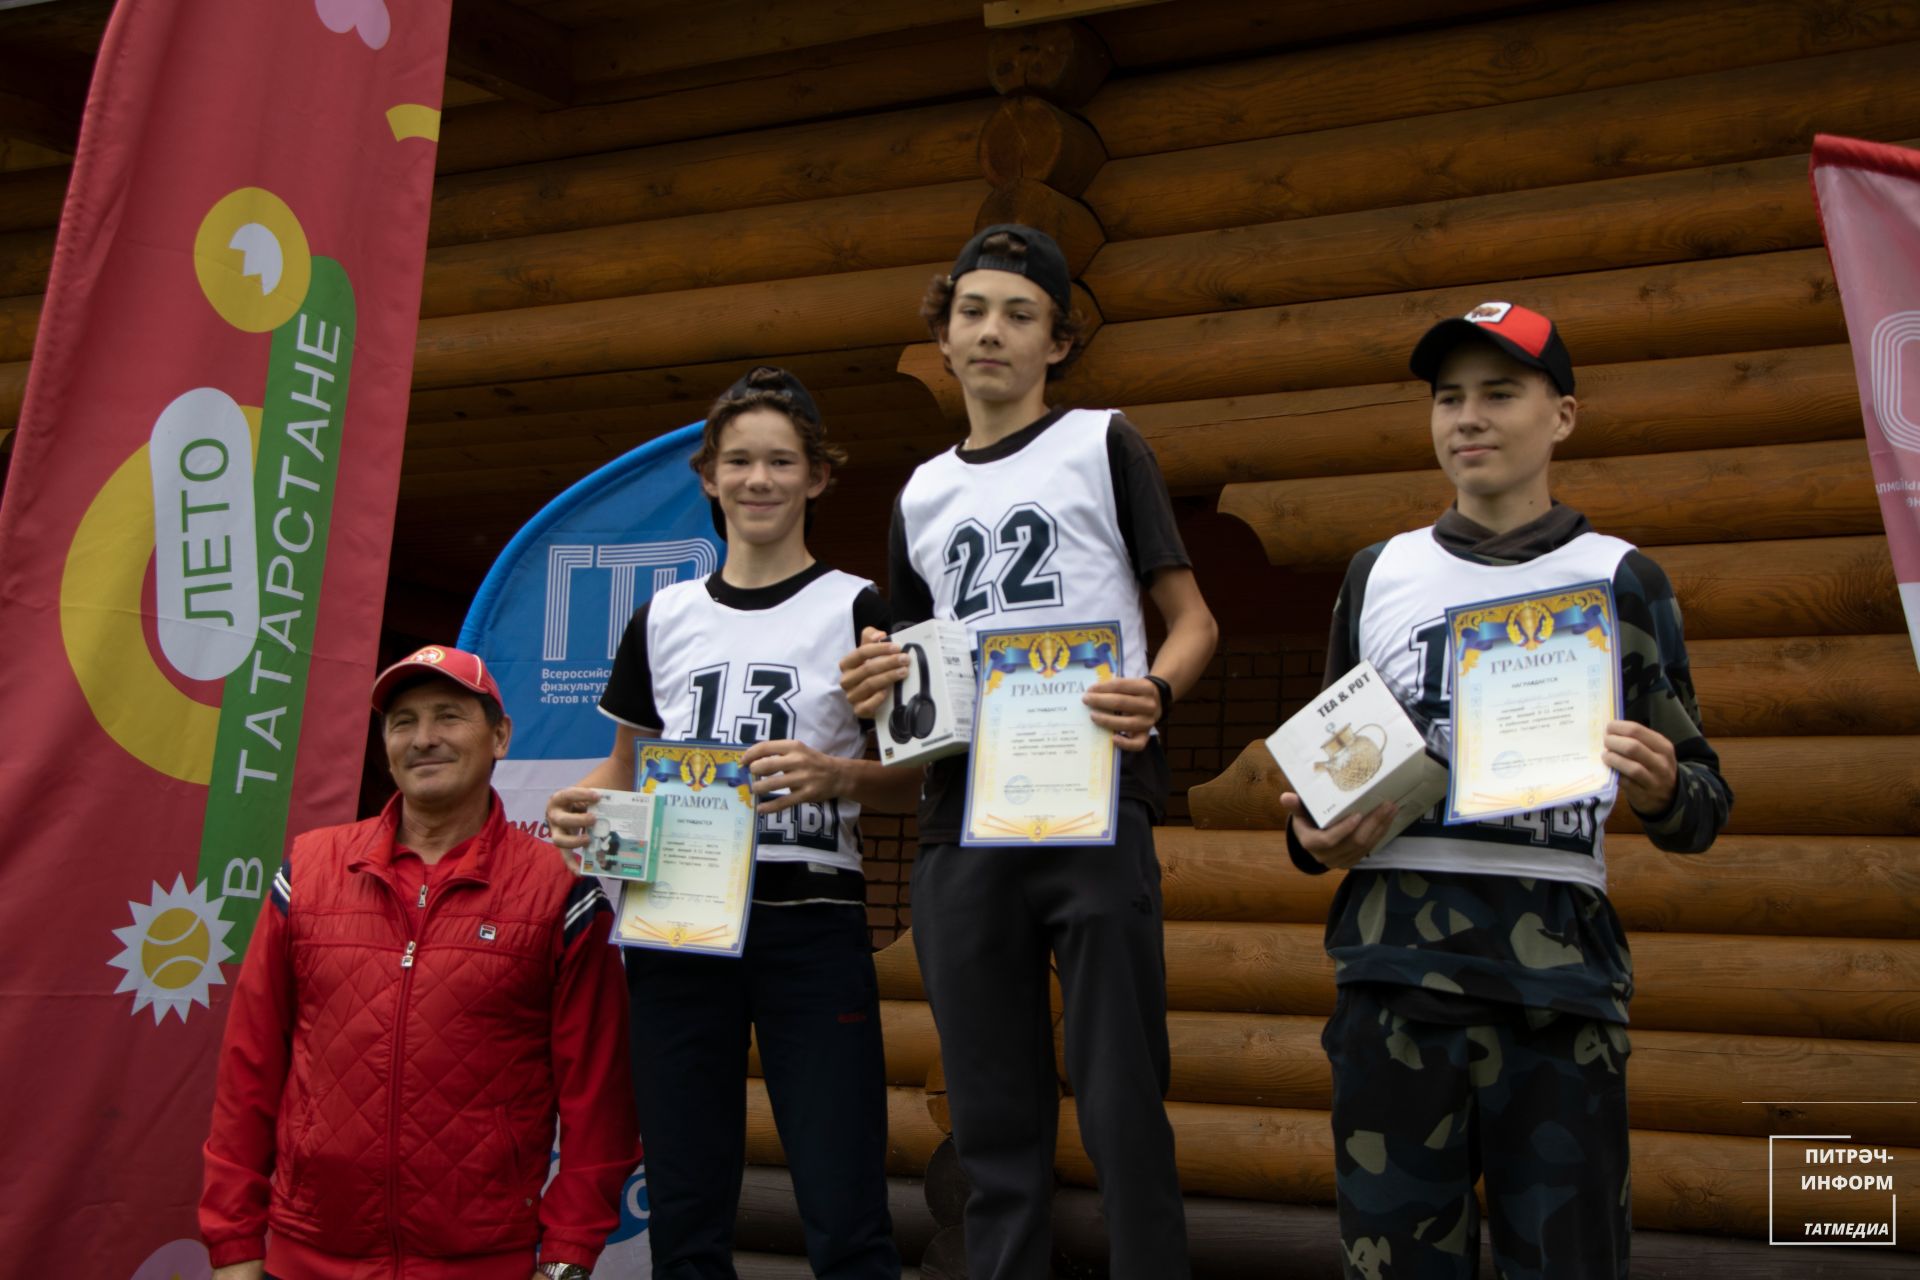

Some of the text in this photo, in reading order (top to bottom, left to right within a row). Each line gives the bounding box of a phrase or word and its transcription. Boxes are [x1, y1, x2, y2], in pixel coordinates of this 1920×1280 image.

[179, 437, 235, 627] ЛЕТО
[944, 501, 1064, 624] 22
[222, 312, 342, 900] В ТАТАРСТАНЕ
[1010, 681, 1086, 698] ГРАМОТА
[1490, 648, 1577, 675] ГРАМОТА
[682, 661, 801, 745] 13
[1316, 672, 1371, 718] TEA & POT
[663, 793, 729, 811] ГРАМОТА
